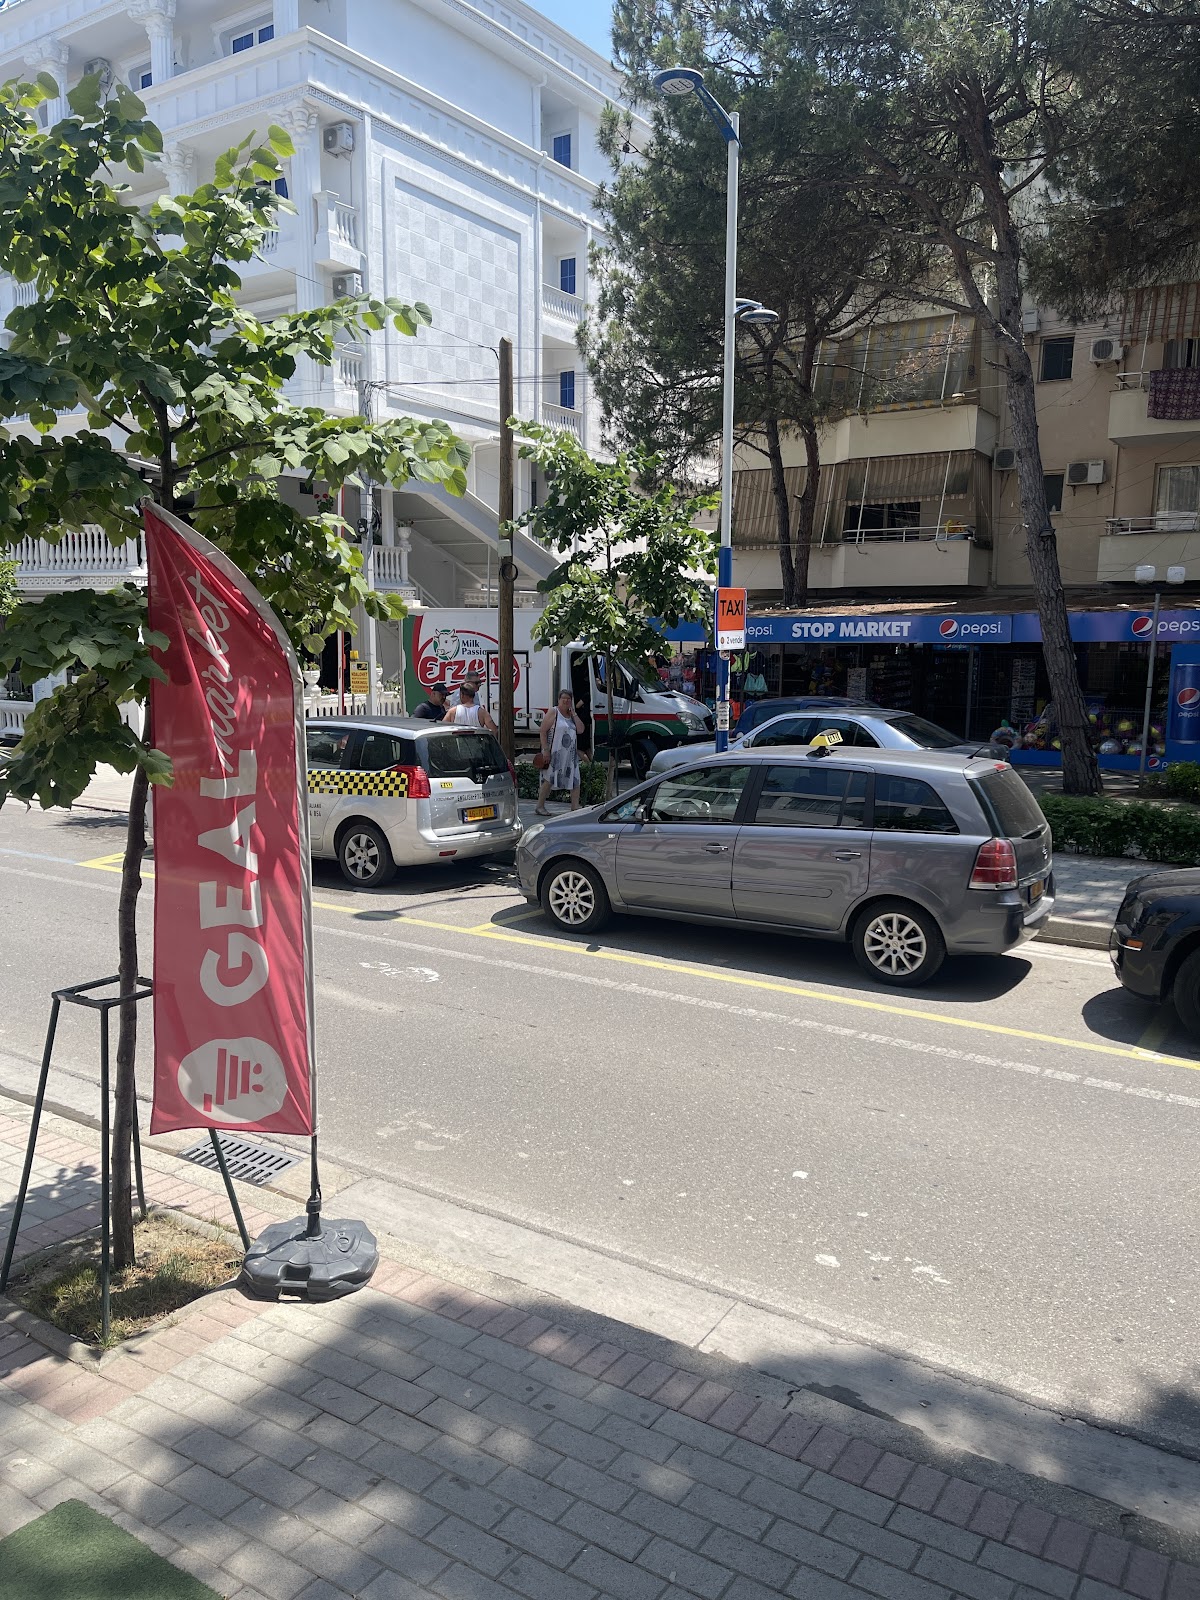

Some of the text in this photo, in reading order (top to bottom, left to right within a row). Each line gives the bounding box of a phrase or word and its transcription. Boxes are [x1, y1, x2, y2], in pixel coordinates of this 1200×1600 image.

[720, 600, 744, 616] TAXI
[792, 621, 912, 637] STOP MARKET
[960, 621, 1001, 637] pepsi
[1157, 621, 1200, 635] peps
[461, 640, 480, 648] Milk
[461, 648, 487, 656] Passio
[187, 569, 270, 1007] GEAL market
